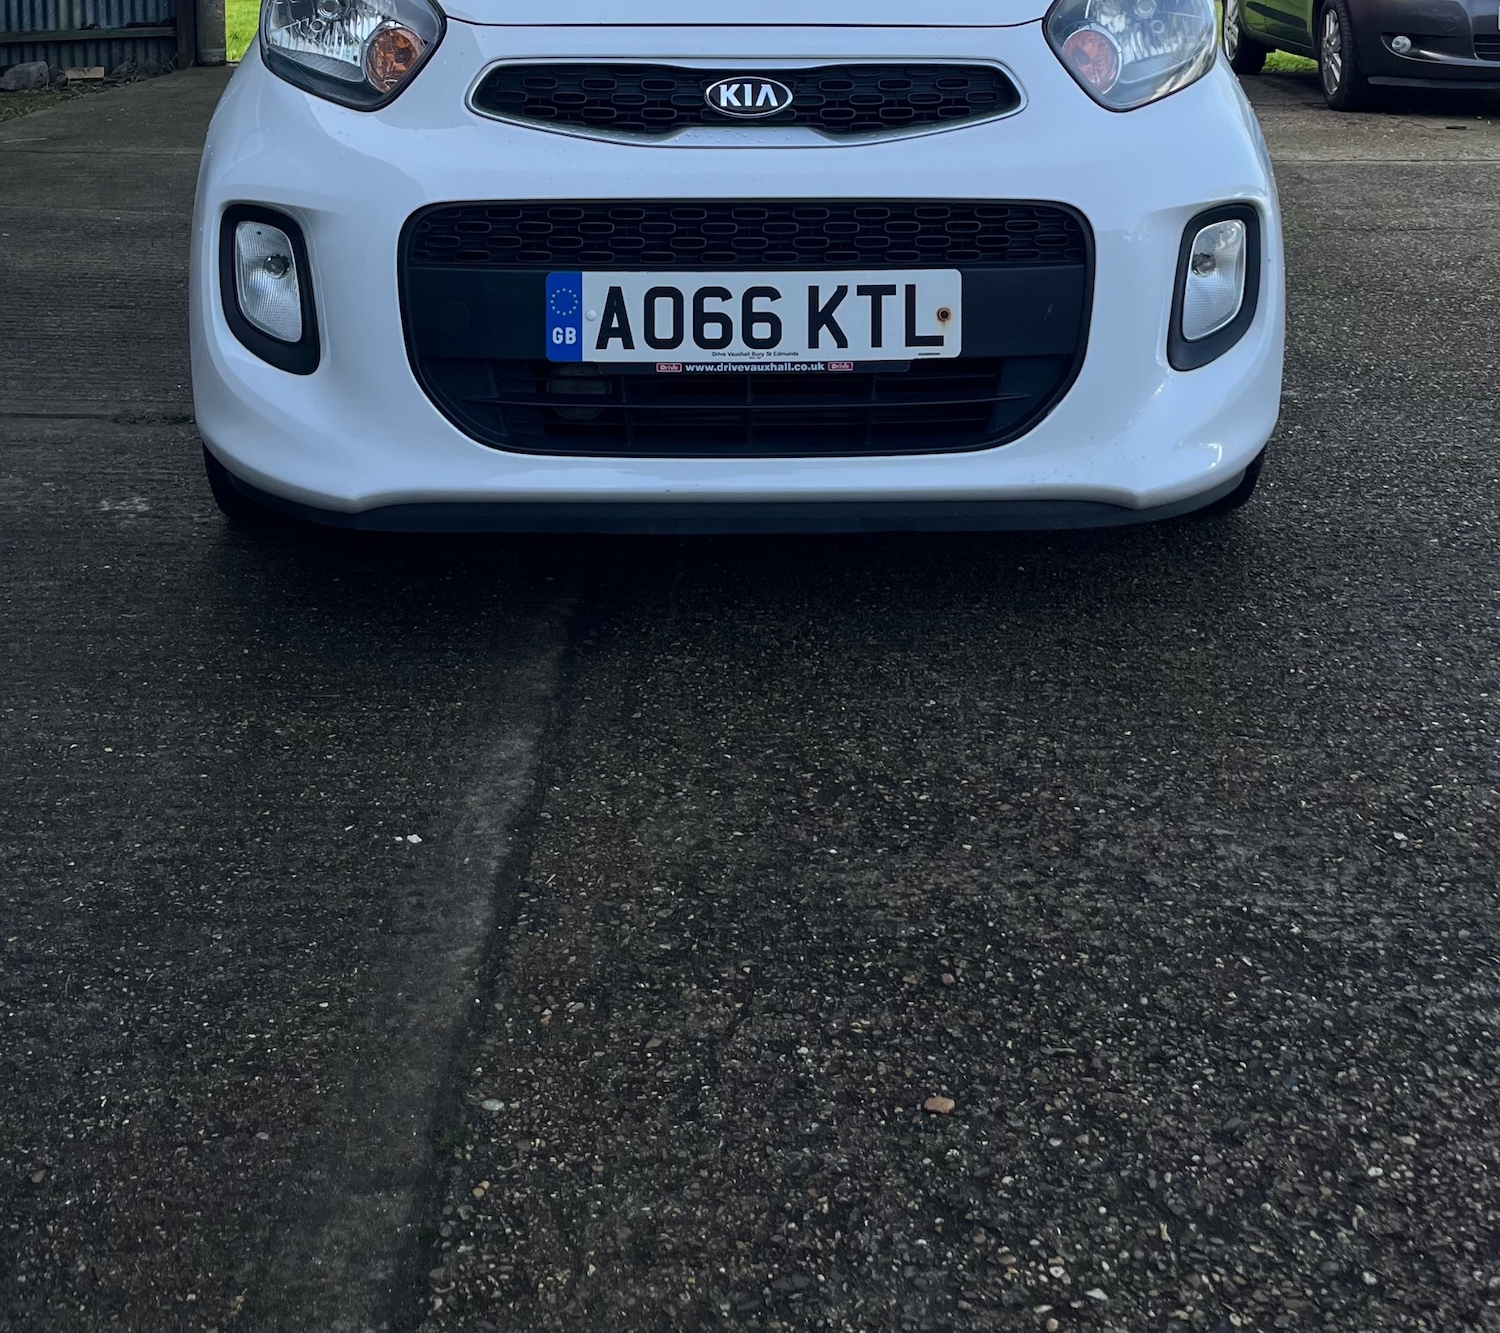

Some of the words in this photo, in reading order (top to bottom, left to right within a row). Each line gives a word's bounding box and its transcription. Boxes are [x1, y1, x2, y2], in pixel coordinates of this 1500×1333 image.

[718, 83, 779, 107] KIA
[807, 283, 945, 350] KTL
[552, 326, 577, 345] GB
[659, 363, 679, 371] Drive
[685, 361, 825, 372] www.drivevauxhall.co.uk
[830, 362, 850, 370] Drive
